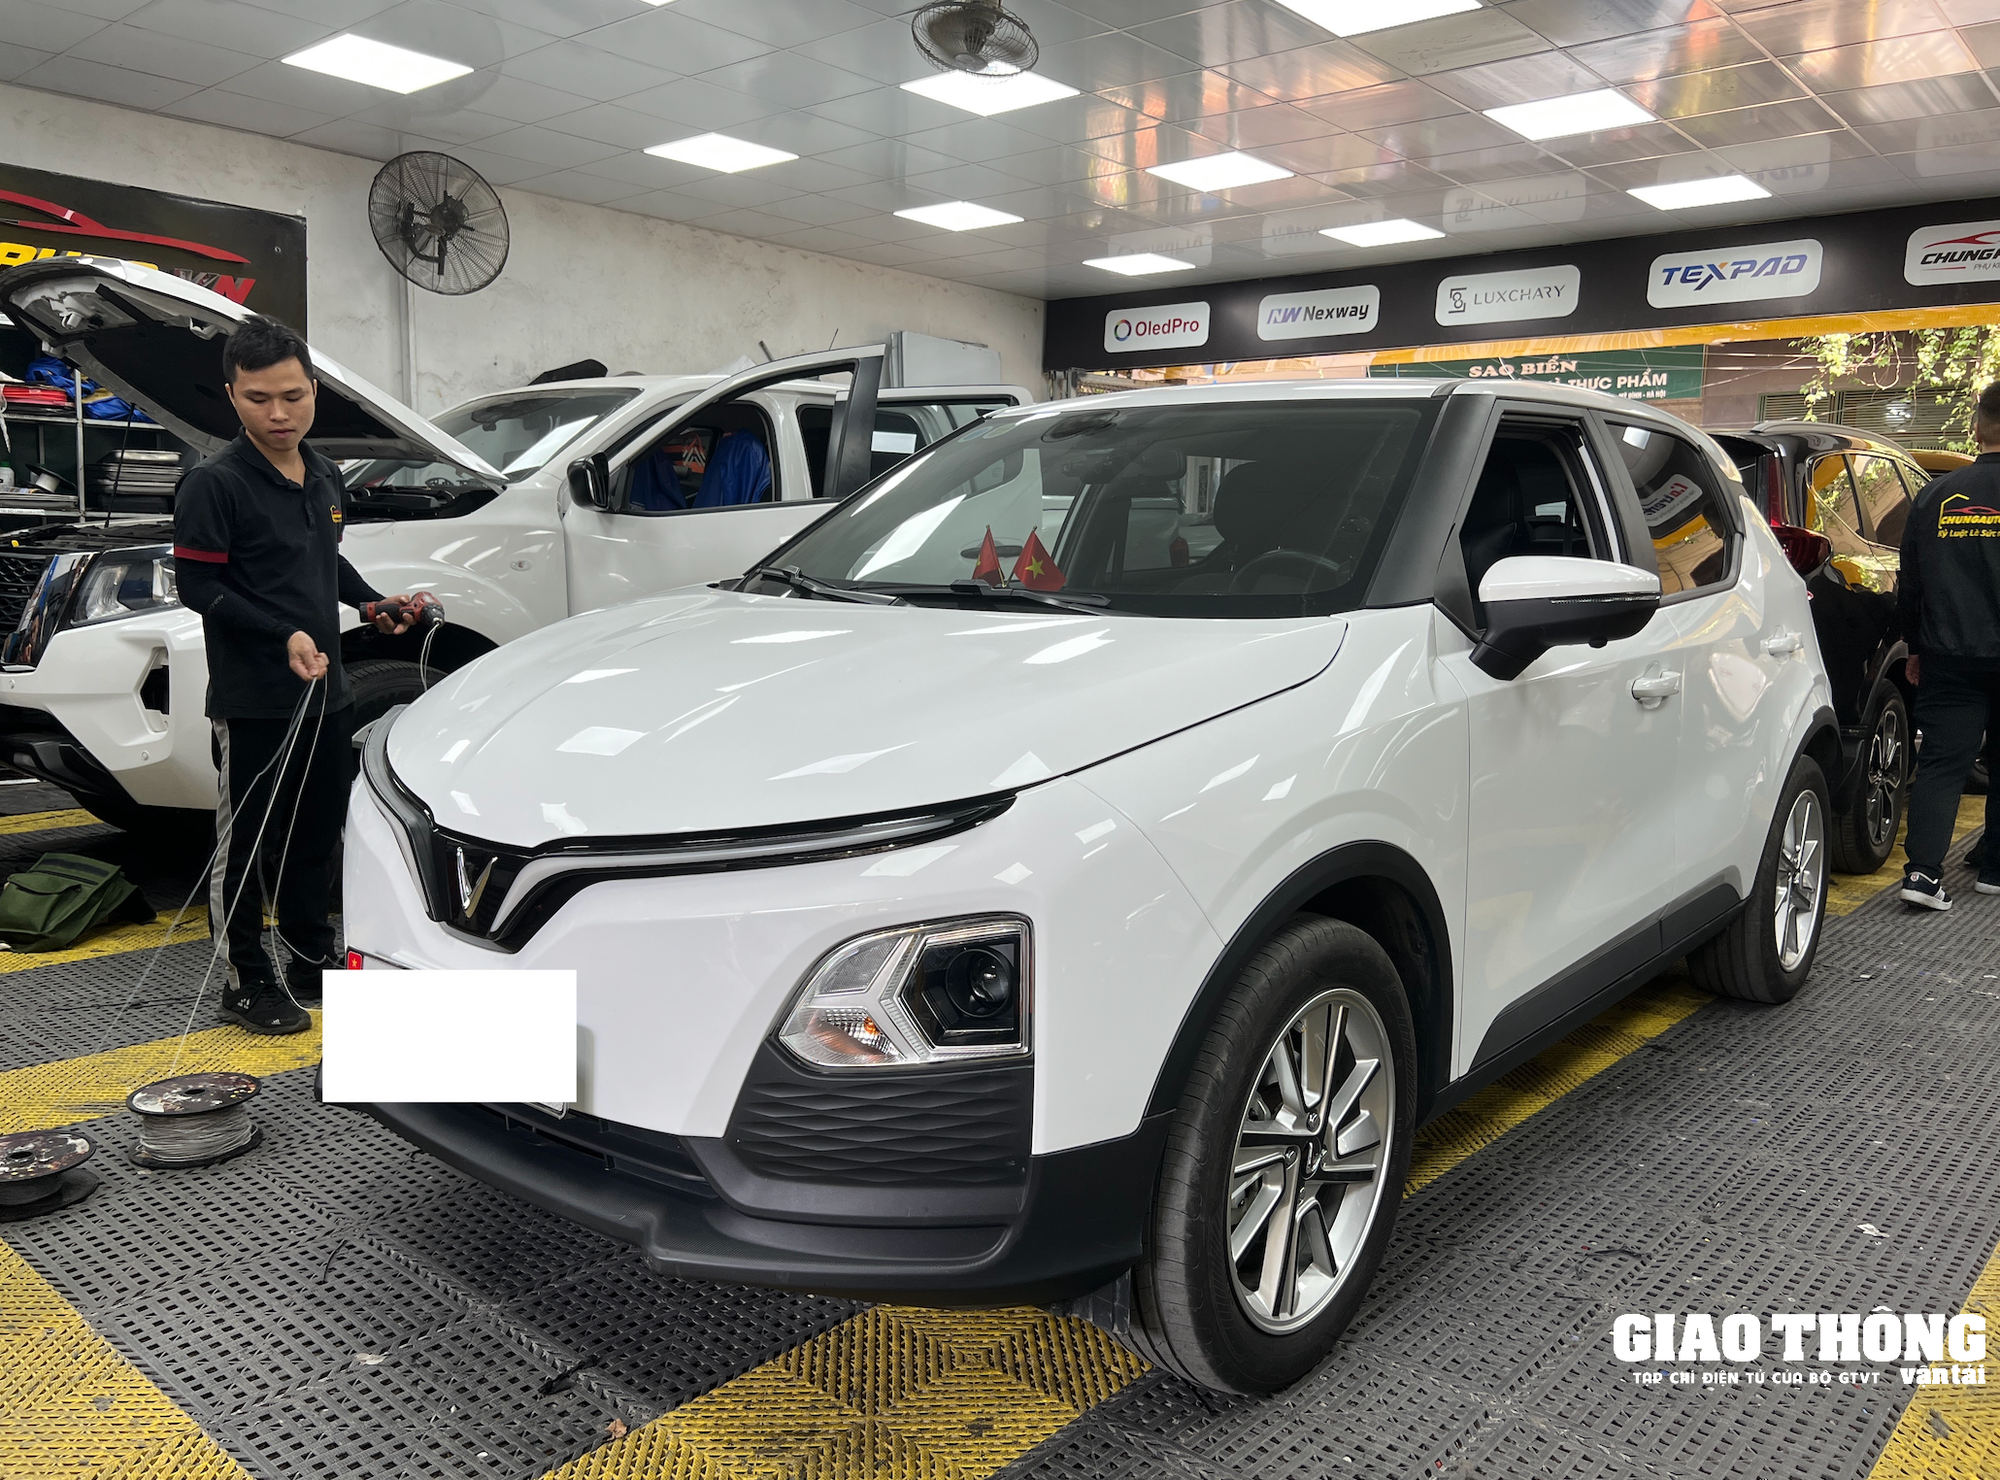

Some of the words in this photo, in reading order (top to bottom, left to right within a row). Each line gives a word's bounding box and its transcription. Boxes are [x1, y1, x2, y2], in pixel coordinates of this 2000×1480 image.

[1661, 254, 1808, 291] TEXPAD
[1473, 284, 1566, 306] LUXCHARY
[1303, 303, 1369, 322] Nexway
[1135, 318, 1199, 337] OledPro
[1468, 365, 1515, 377] SAO
[1521, 355, 1578, 375] BIỂN
